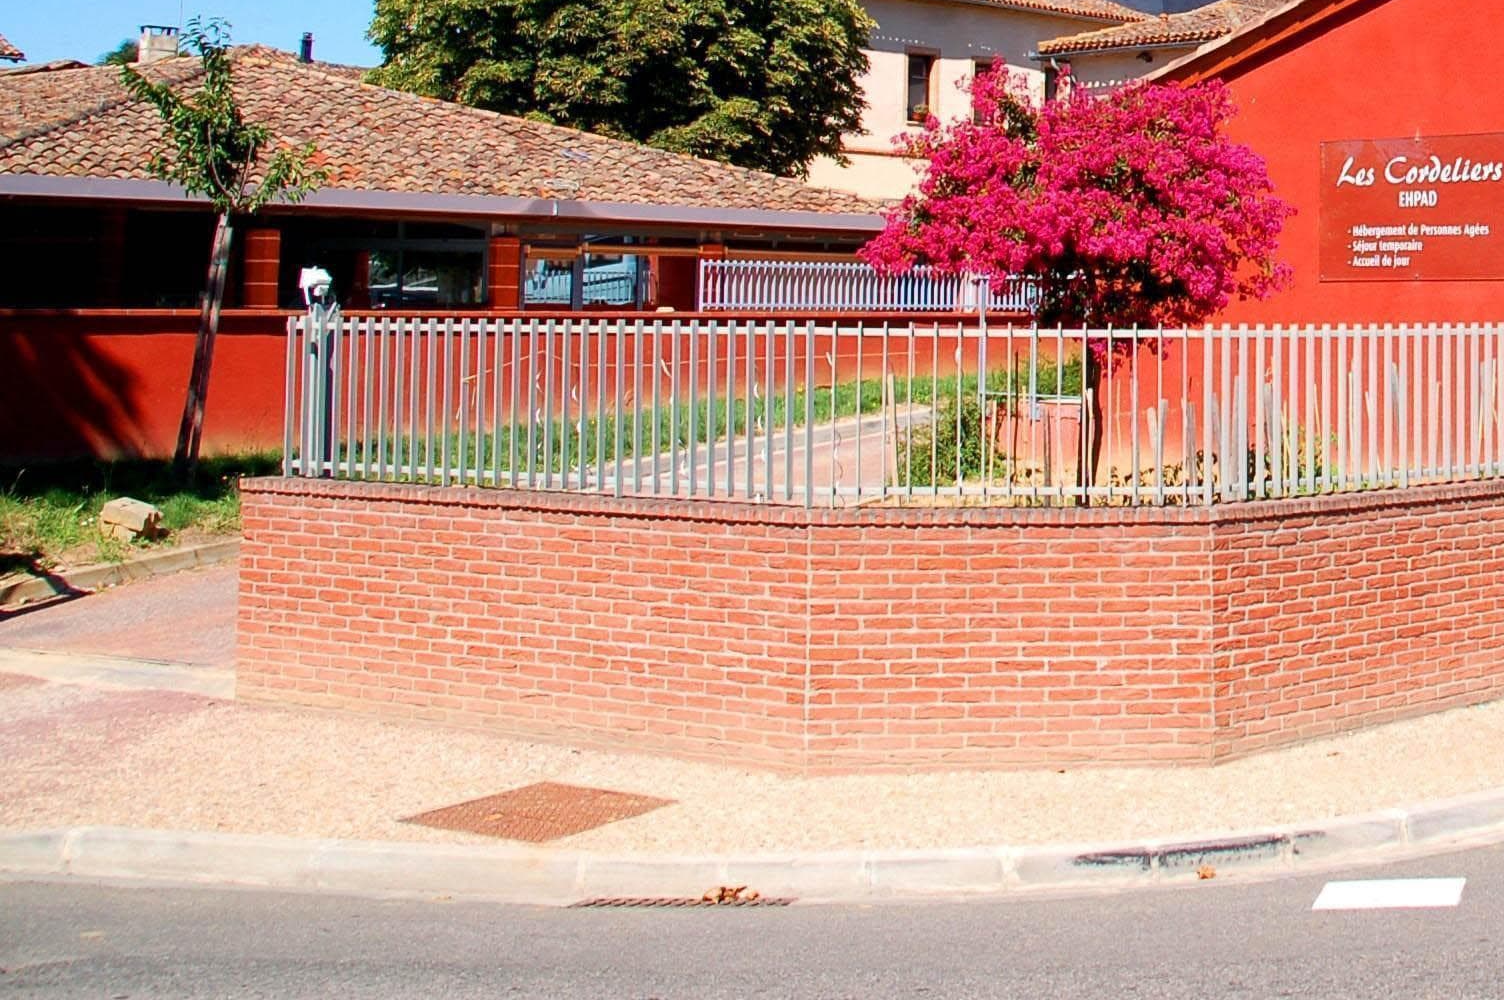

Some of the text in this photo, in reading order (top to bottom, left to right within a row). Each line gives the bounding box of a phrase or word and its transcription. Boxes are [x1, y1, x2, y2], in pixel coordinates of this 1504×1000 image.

[1336, 155, 1503, 187] Les Cordeliers
[1398, 190, 1438, 208] EHPAD
[1352, 224, 1406, 238] Hébergement
[1407, 223, 1419, 235] de
[1420, 224, 1462, 235] Personnes
[1352, 239, 1423, 254] Séjour temporaire
[1352, 255, 1410, 269] Accueil de jour
